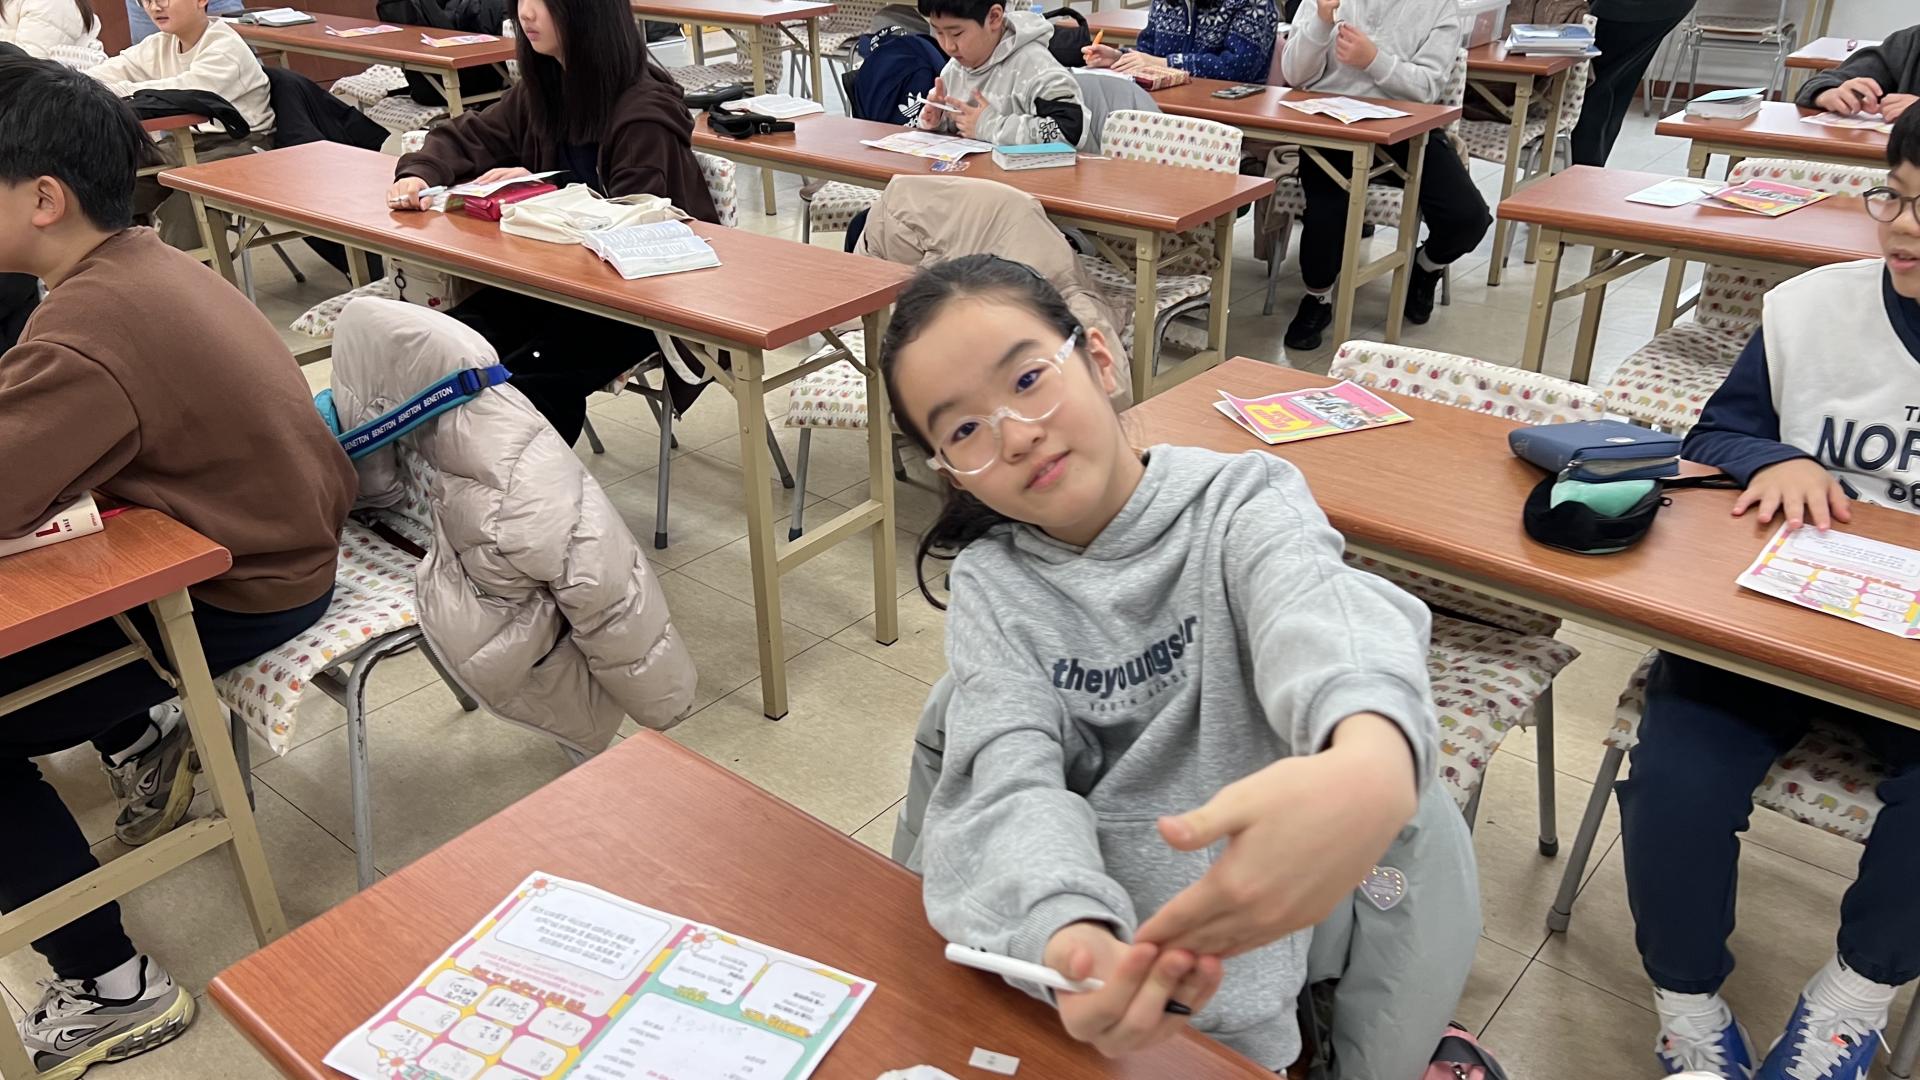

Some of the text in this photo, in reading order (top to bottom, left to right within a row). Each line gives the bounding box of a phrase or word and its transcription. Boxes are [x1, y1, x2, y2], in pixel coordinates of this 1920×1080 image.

[371, 419, 397, 438] BENETTON
[398, 403, 422, 423] BENETTON
[423, 387, 453, 407] BENETTON
